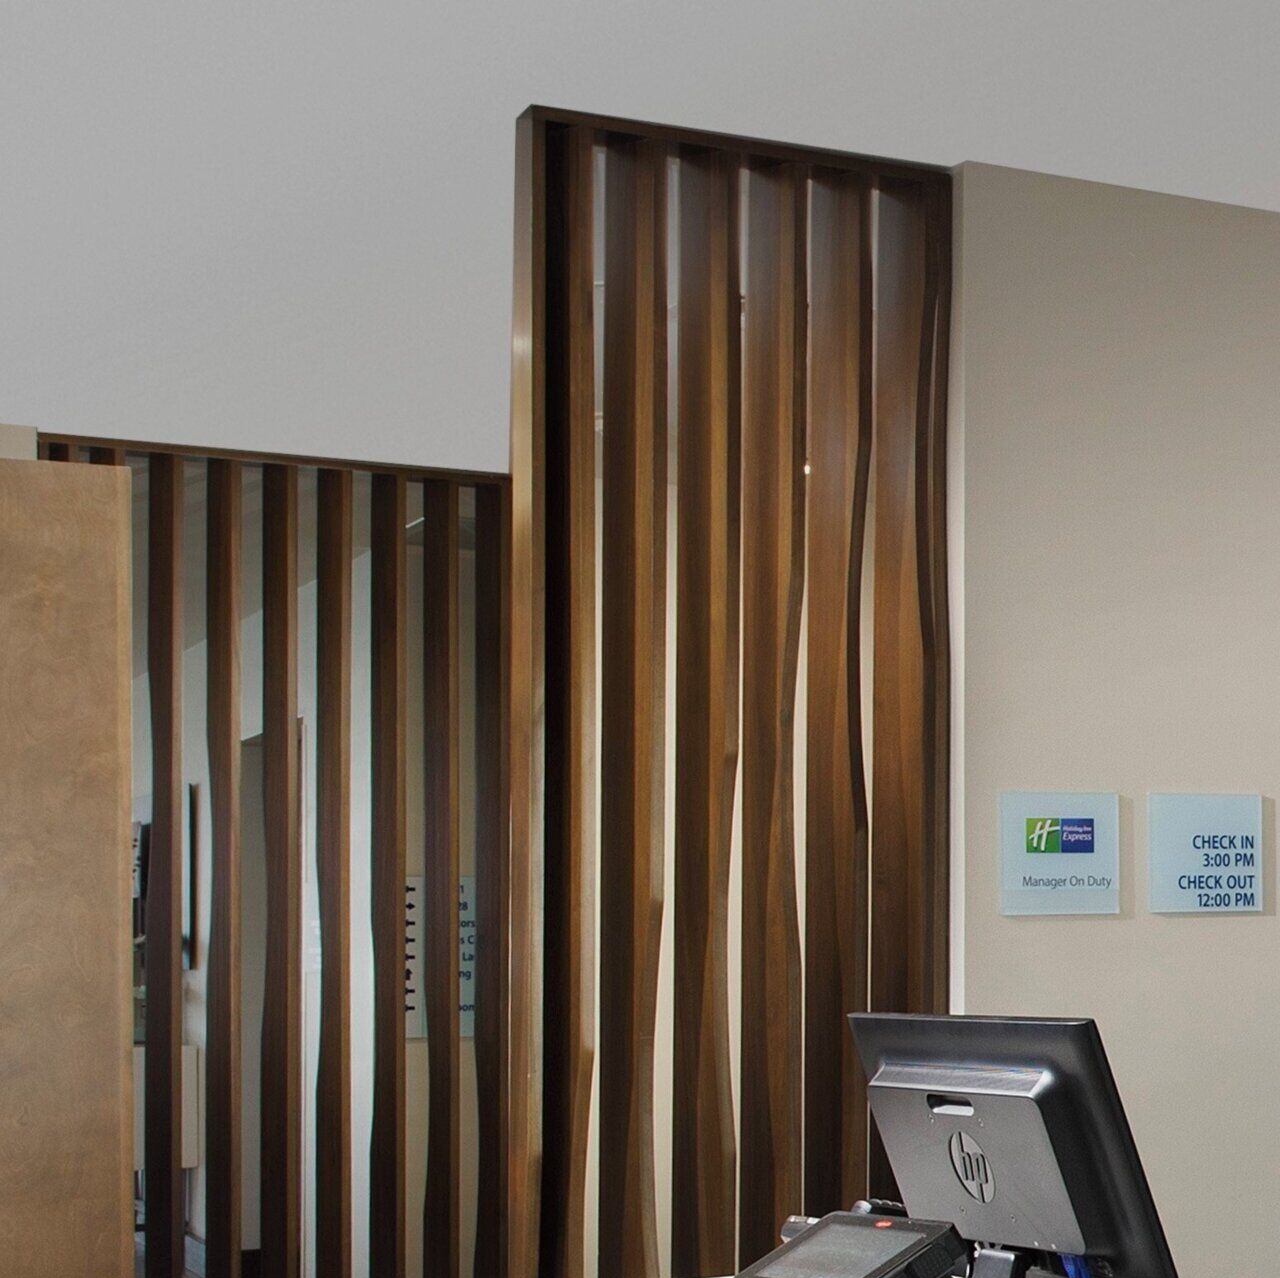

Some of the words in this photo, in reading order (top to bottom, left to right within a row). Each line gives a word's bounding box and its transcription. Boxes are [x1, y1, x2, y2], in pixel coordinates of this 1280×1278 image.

[1062, 832, 1092, 842] Express
[1192, 834, 1237, 849] CHECK
[1240, 834, 1254, 849] IN
[1202, 853, 1231, 867] 3:00
[1234, 852, 1255, 867] PM
[1022, 875, 1067, 889] Manager
[1069, 875, 1085, 887] On
[1087, 875, 1112, 889] Duty
[1178, 874, 1223, 889] CHECK
[1226, 874, 1255, 889] OUT
[1197, 892, 1231, 907] 12:00
[1234, 892, 1255, 907] PM
